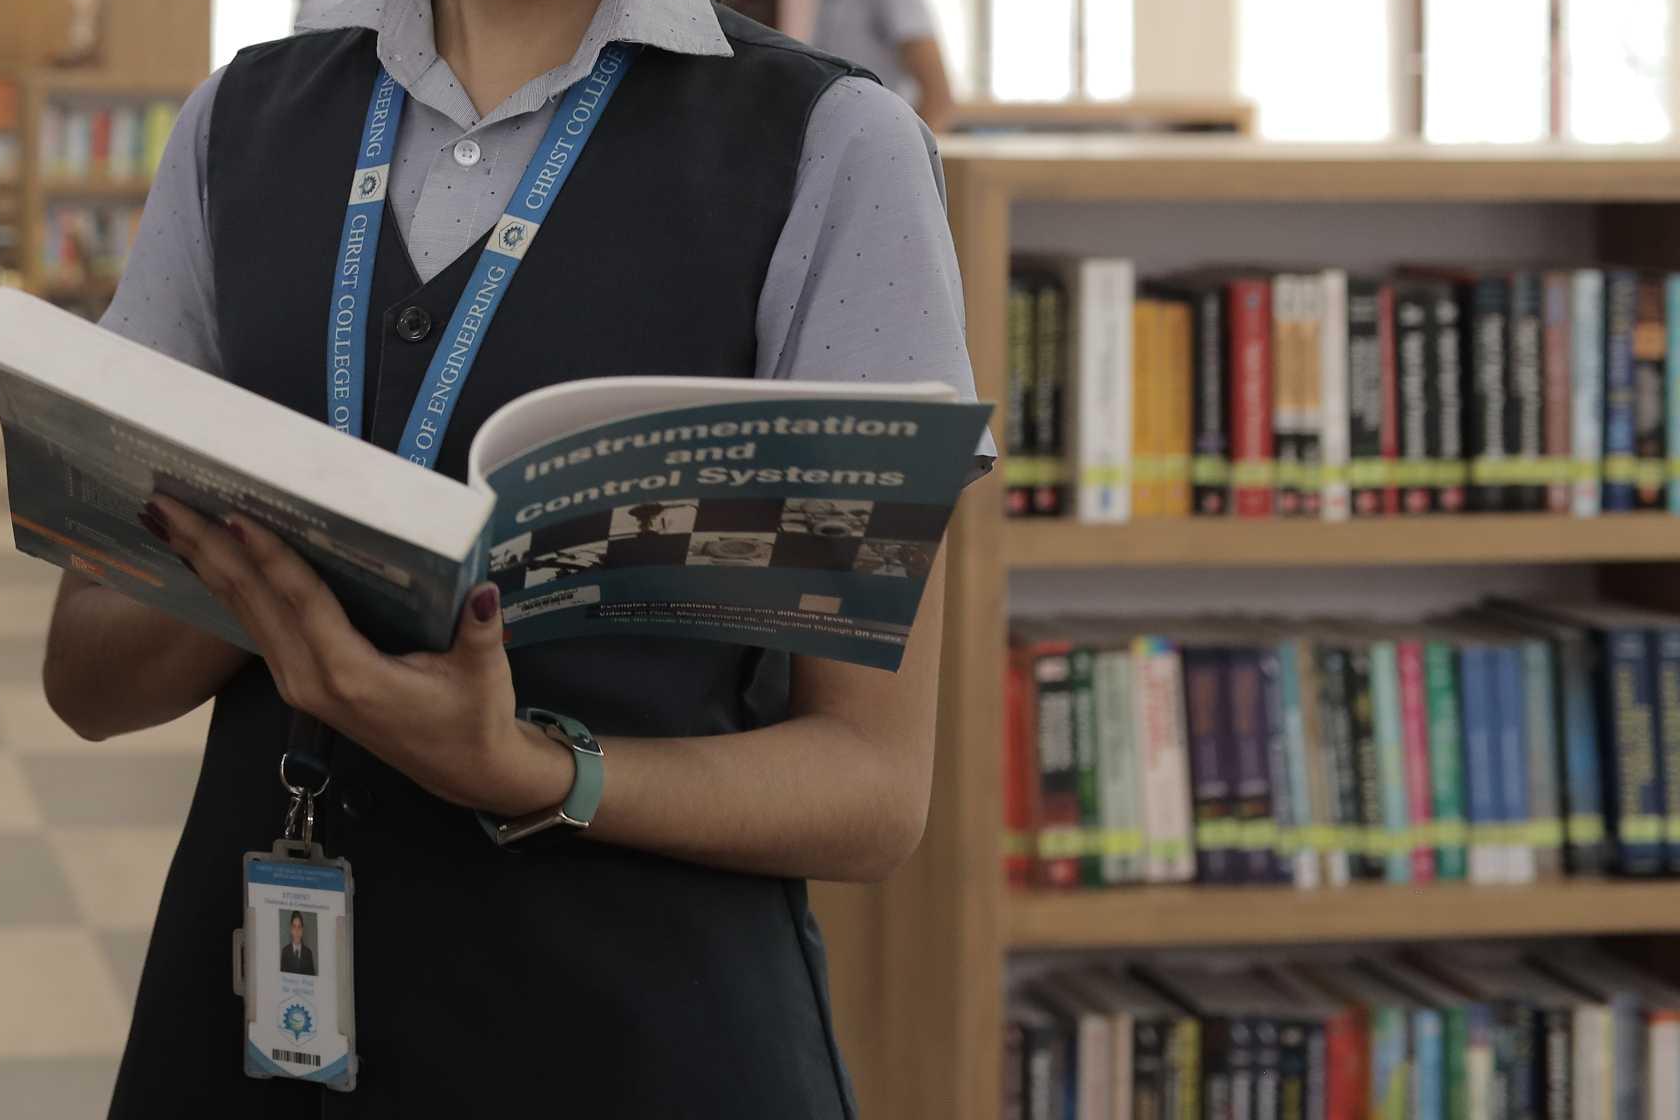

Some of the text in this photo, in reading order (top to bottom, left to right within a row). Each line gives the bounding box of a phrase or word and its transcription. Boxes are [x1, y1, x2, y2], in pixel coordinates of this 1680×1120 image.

[526, 46, 625, 210] CHRIST COLLEGE
[342, 214, 368, 289] CHRIST
[334, 294, 355, 400] COLLEGE
[415, 265, 506, 450] OF ENGINEERING
[525, 416, 918, 482] Instrumentation
[664, 441, 756, 465] and
[515, 465, 905, 523] Control Systems
